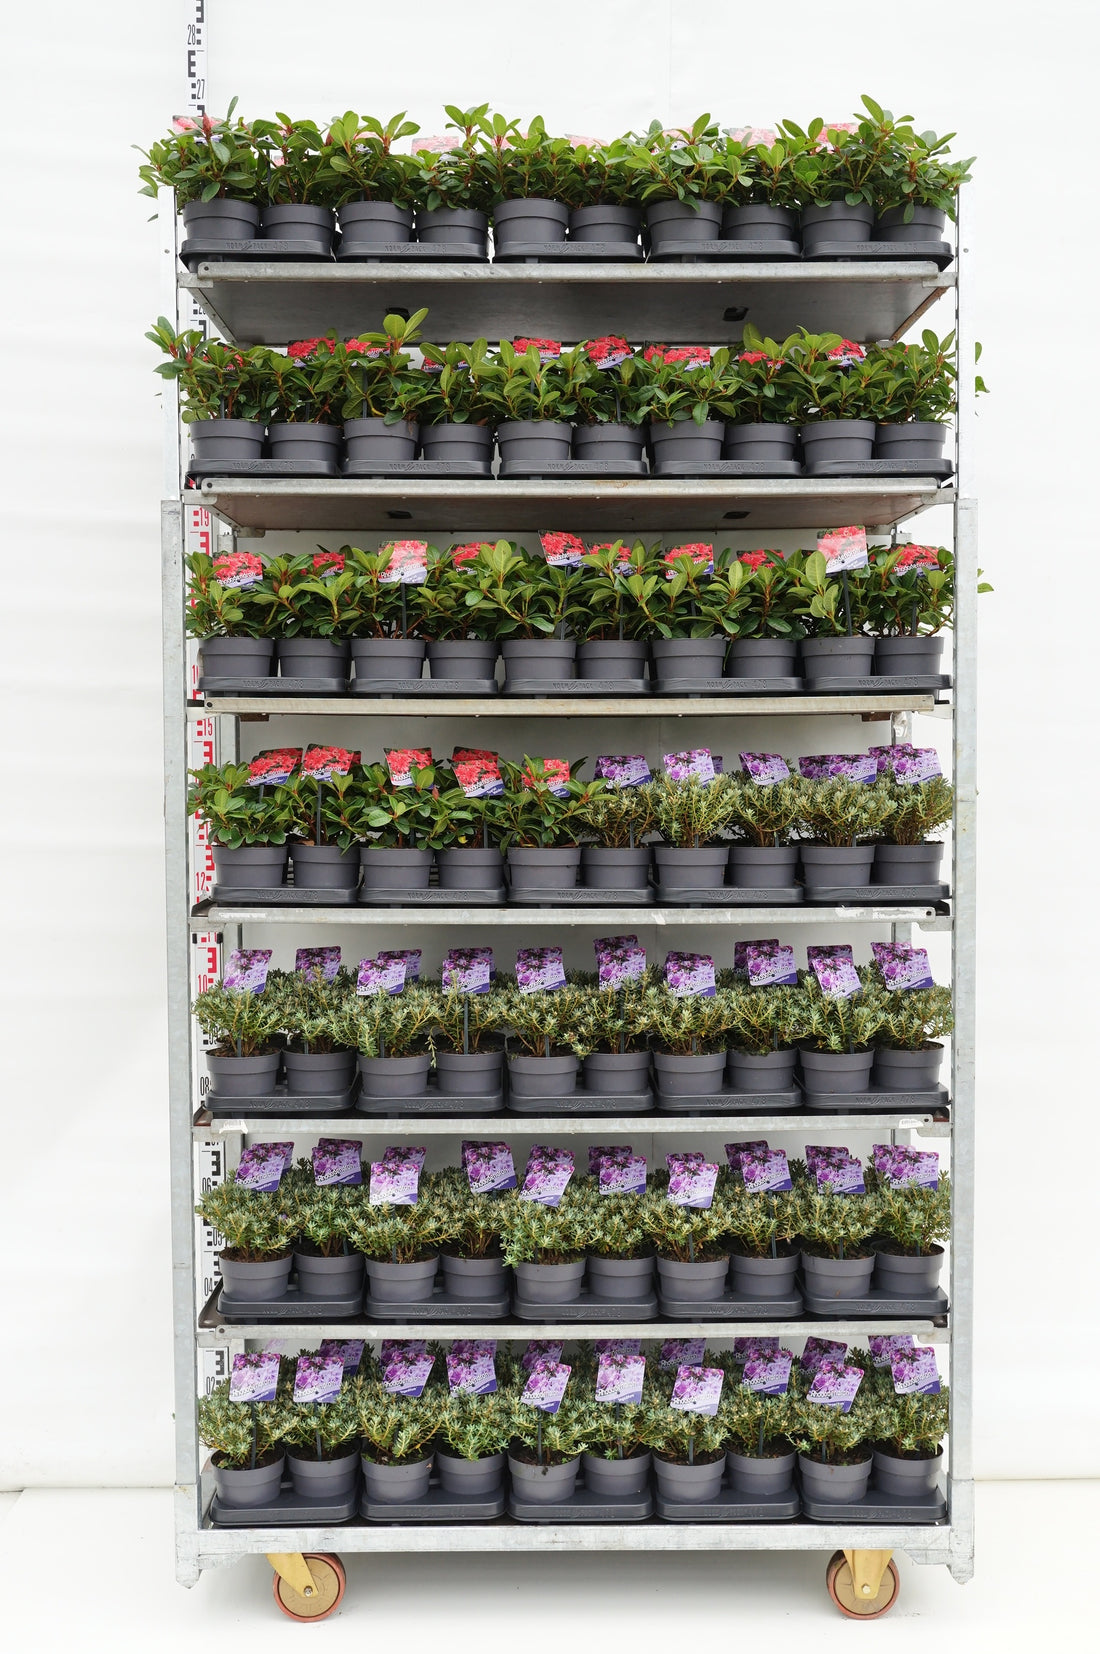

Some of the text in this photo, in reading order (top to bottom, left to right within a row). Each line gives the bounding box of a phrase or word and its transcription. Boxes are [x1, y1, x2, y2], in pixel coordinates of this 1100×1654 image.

[187, 24, 196, 45] 28
[196, 79, 205, 100] 27
[202, 718, 213, 736] 15
[195, 872, 206, 891] 12
[198, 974, 208, 993] 10
[212, 1227, 223, 1246] 05
[206, 1376, 216, 1396] 02
